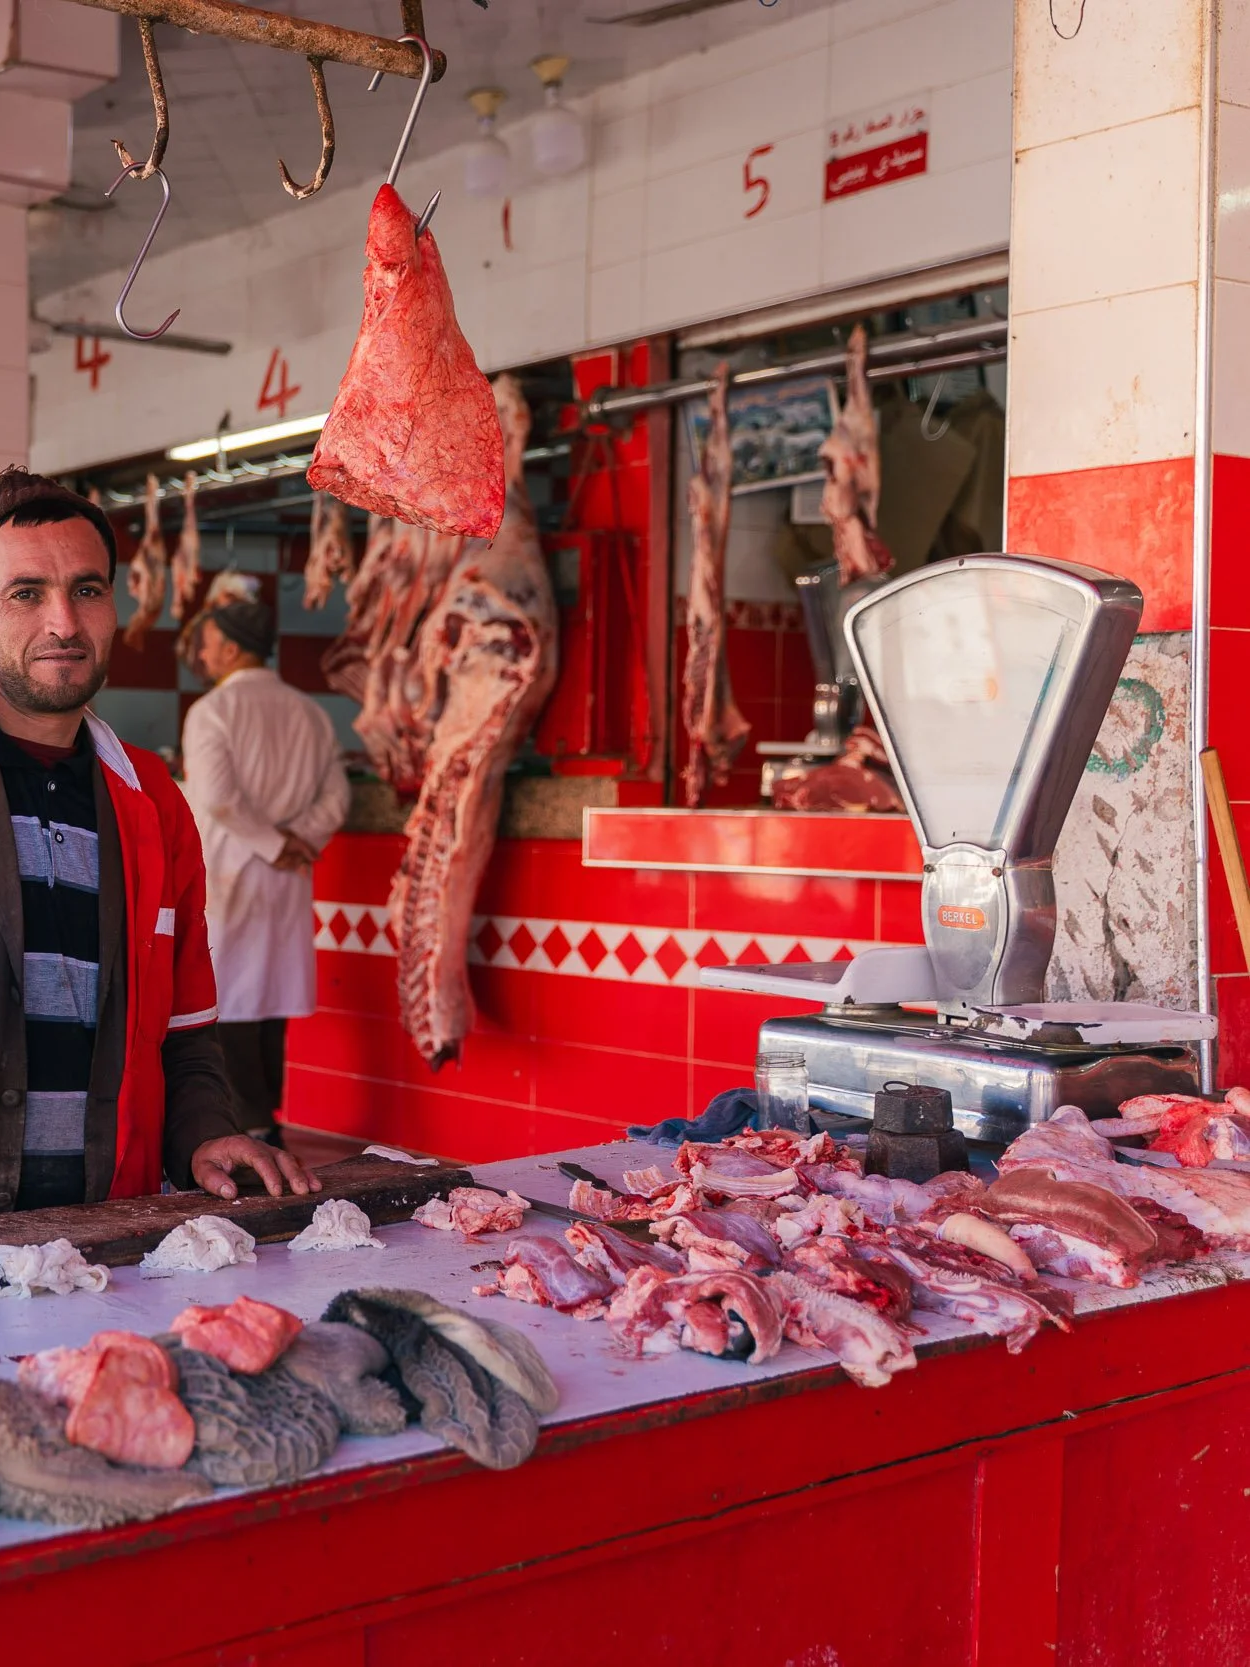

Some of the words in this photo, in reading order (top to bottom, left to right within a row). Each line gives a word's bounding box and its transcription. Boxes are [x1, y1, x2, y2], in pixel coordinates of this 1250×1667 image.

[743, 143, 774, 219] 5
[75, 319, 112, 391] 4
[256, 344, 302, 418] 4
[941, 910, 978, 925] BERKEL
